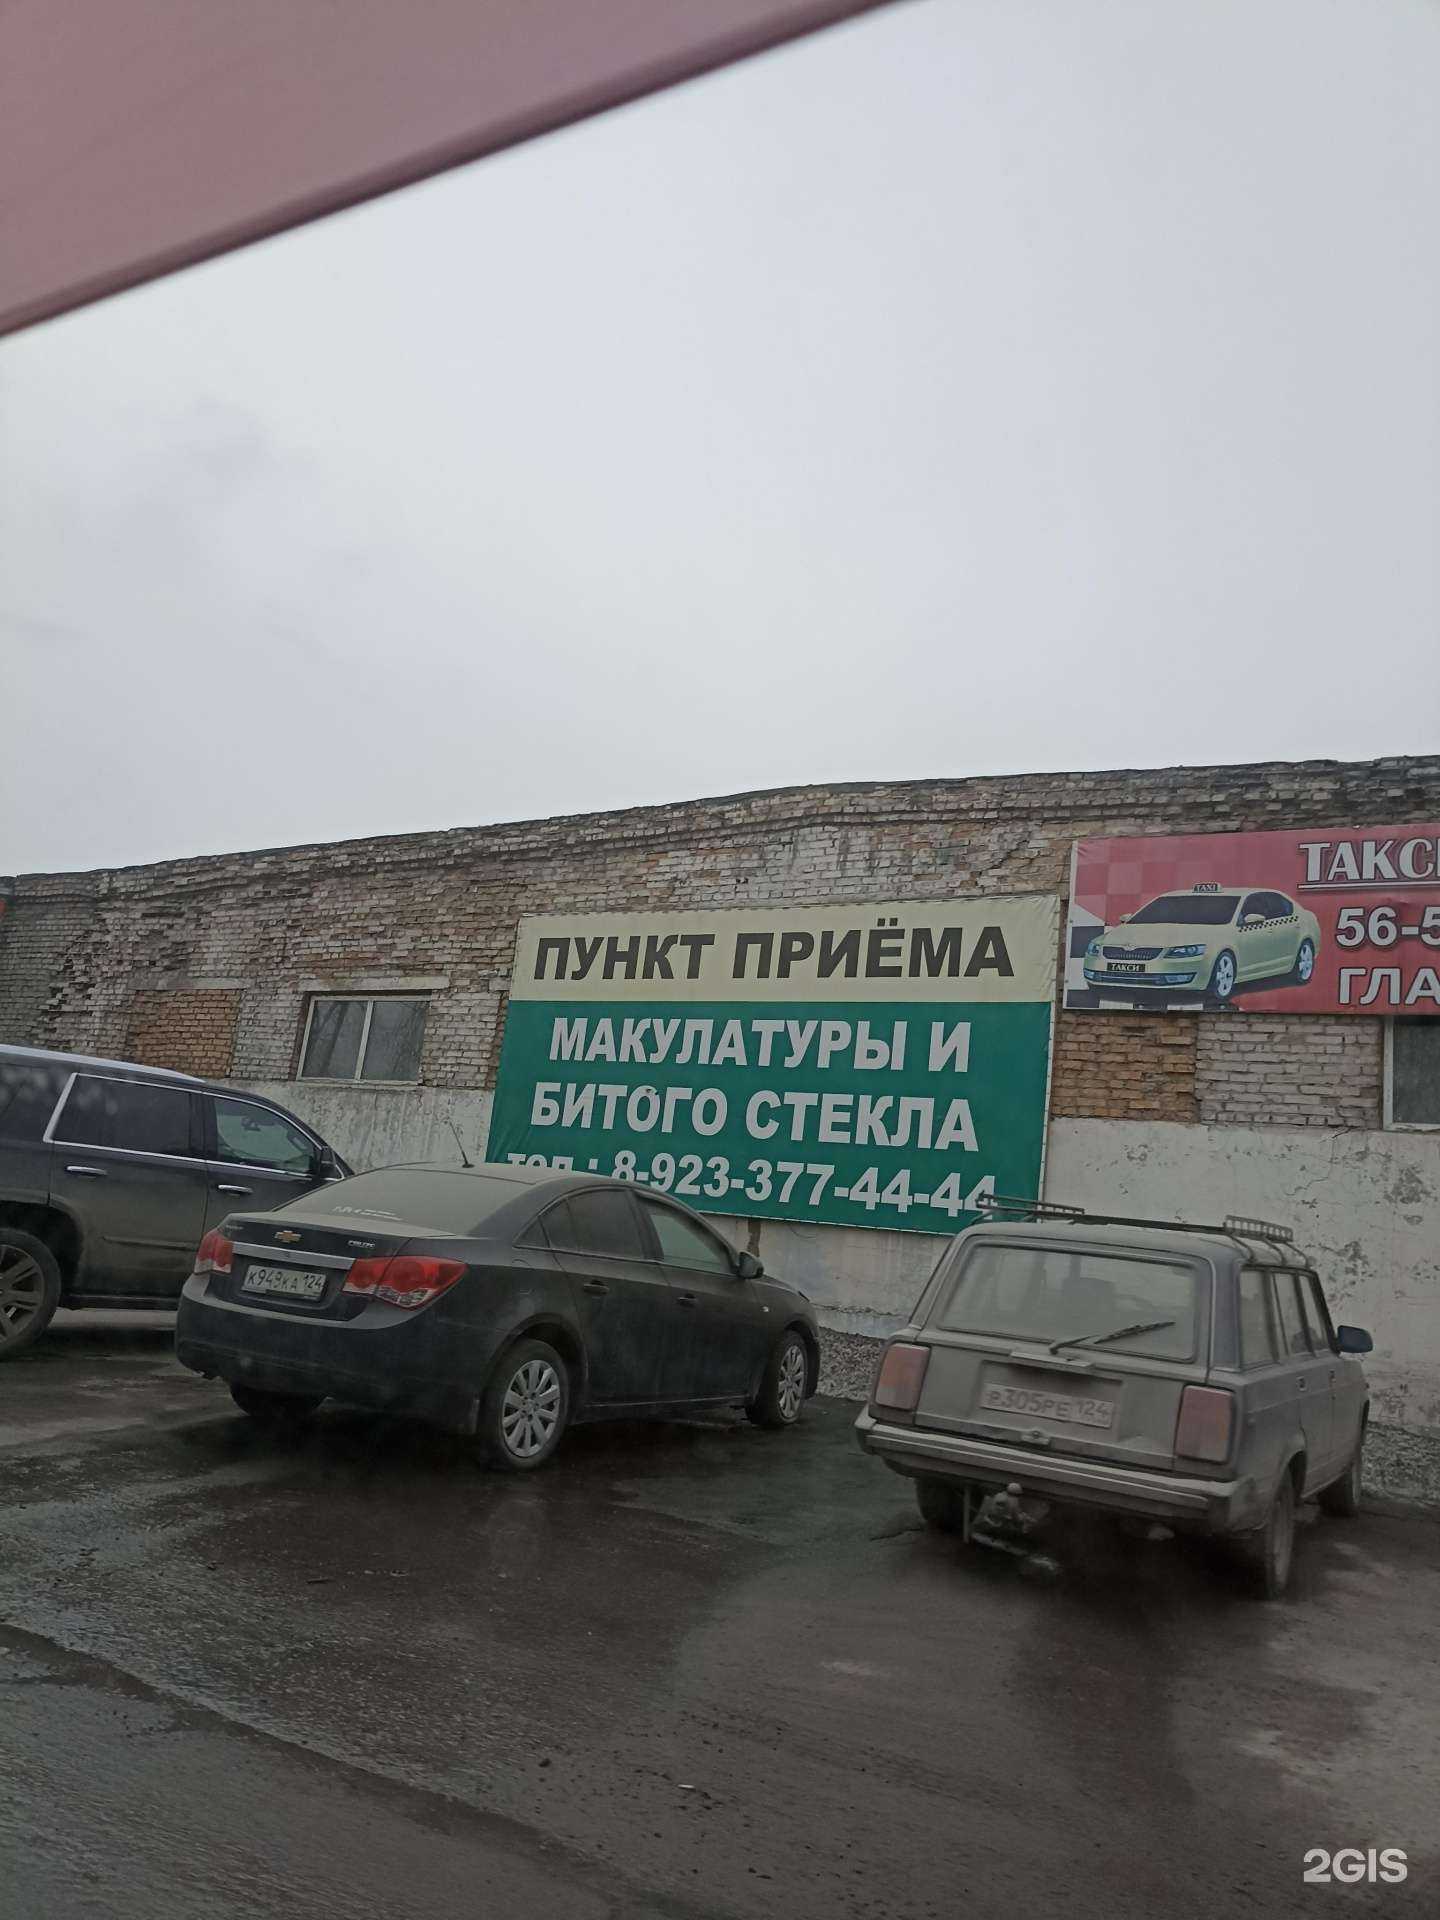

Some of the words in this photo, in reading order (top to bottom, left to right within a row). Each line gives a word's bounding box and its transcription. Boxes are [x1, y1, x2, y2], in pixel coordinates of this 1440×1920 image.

[1299, 838, 1440, 882] ТАКС
[533, 933, 716, 981] ПУНКТ
[731, 918, 1015, 979] ПРИЁМА
[1336, 906, 1440, 947] 56-5
[1339, 967, 1440, 1006] ГЛА
[548, 1017, 908, 1071] МАКУЛАТУРЫ
[927, 1021, 972, 1073] И
[529, 1081, 728, 1137] БИТОГО
[745, 1090, 979, 1152] СТЕКЛА
[611, 1150, 998, 1220] 8-923-377-44-44
